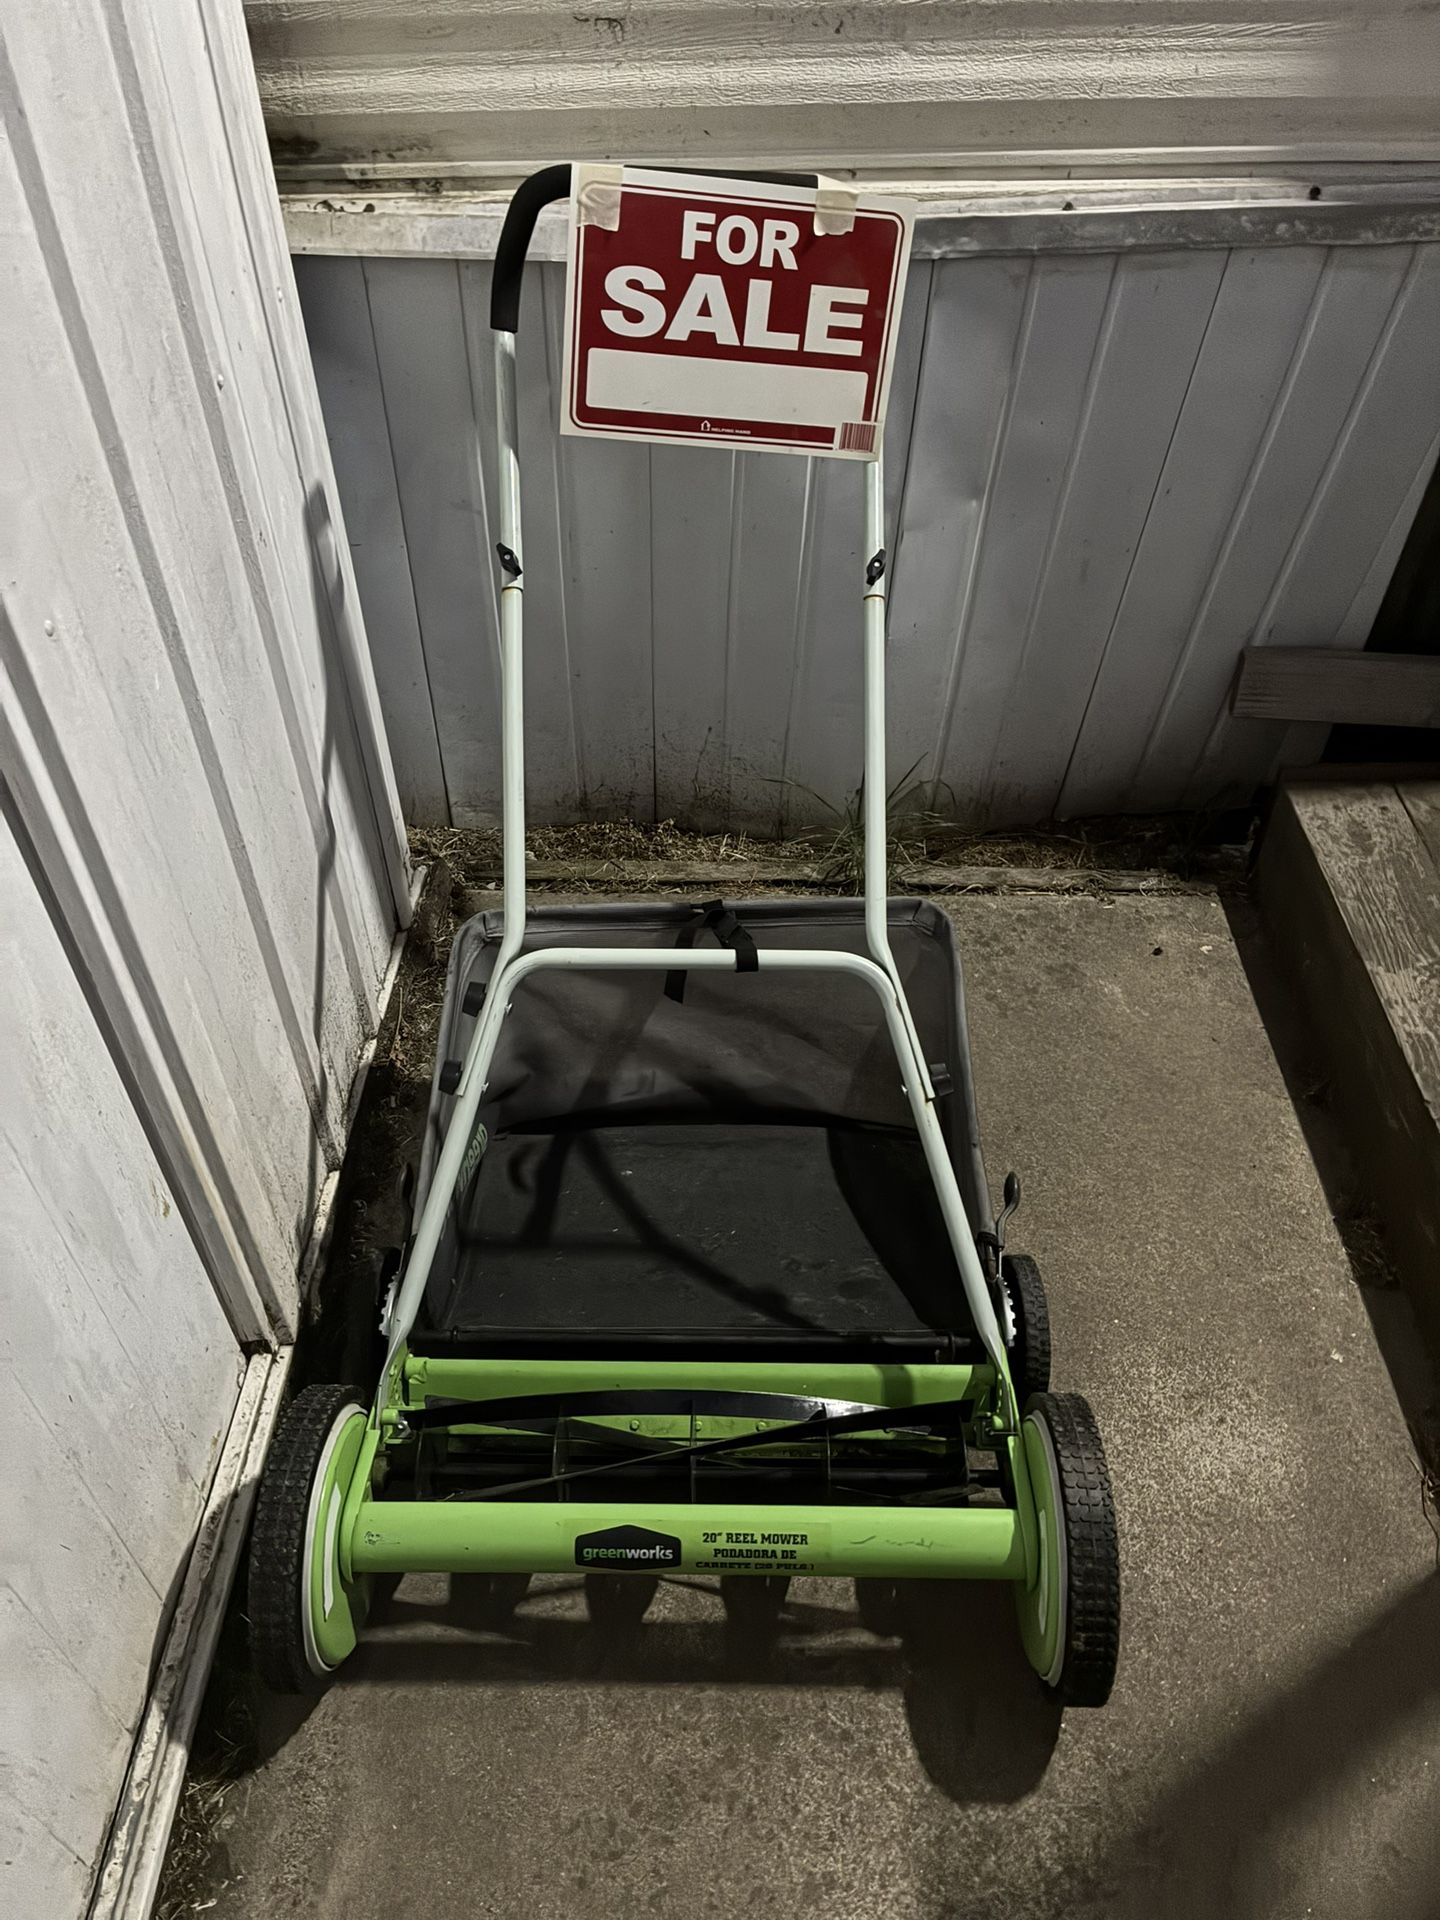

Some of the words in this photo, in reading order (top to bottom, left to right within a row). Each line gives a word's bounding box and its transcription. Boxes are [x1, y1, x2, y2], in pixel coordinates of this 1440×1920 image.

[681, 210, 800, 271] FOR
[600, 265, 870, 357] SALE
[726, 1532, 757, 1544] REEL
[760, 1533, 808, 1545] MOWER
[583, 1545, 674, 1561] greenworks
[713, 1548, 778, 1559] PODADORA
[781, 1550, 797, 1560] DE
[696, 1561, 752, 1569] CARRETE
